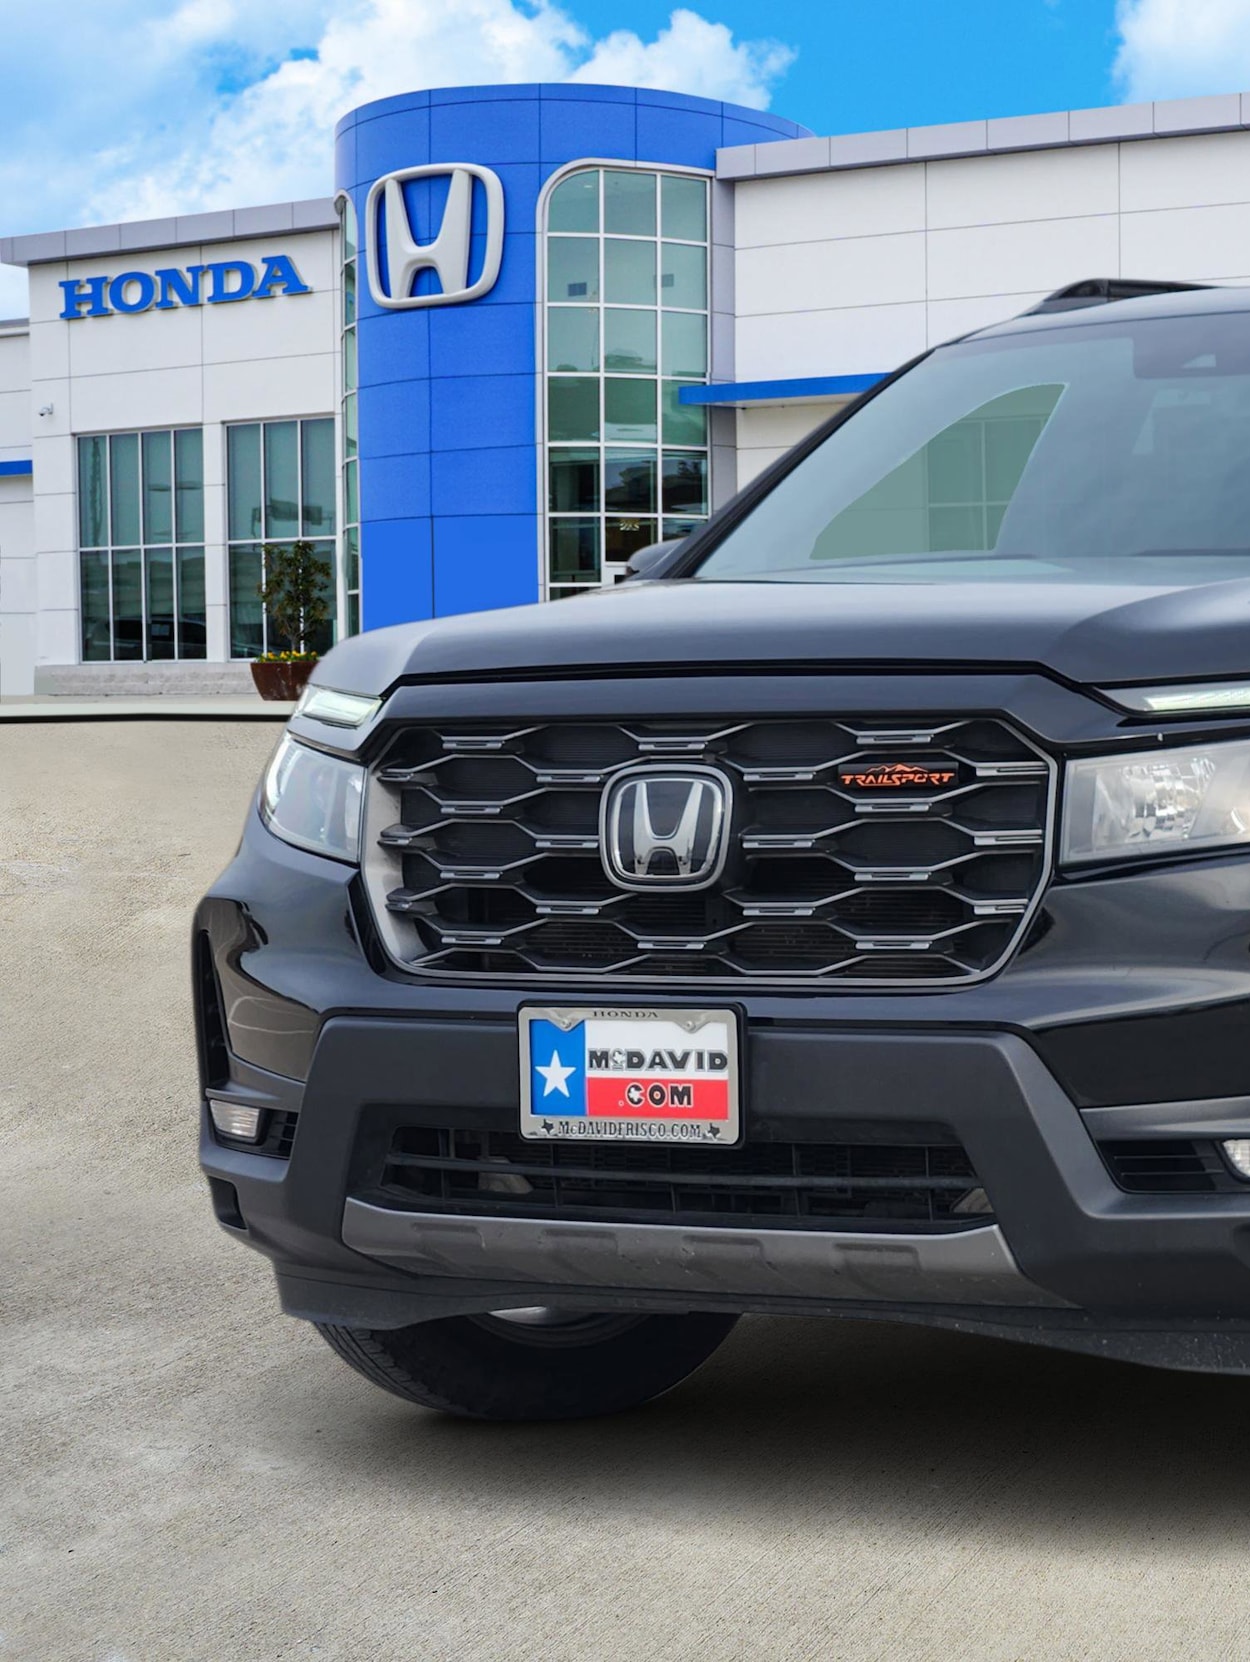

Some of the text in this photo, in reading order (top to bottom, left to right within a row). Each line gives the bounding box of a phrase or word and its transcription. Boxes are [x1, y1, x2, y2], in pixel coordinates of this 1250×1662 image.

[58, 254, 312, 320] HONDA
[841, 773, 955, 787] TRAILSPORT
[593, 1010, 659, 1019] HONDA
